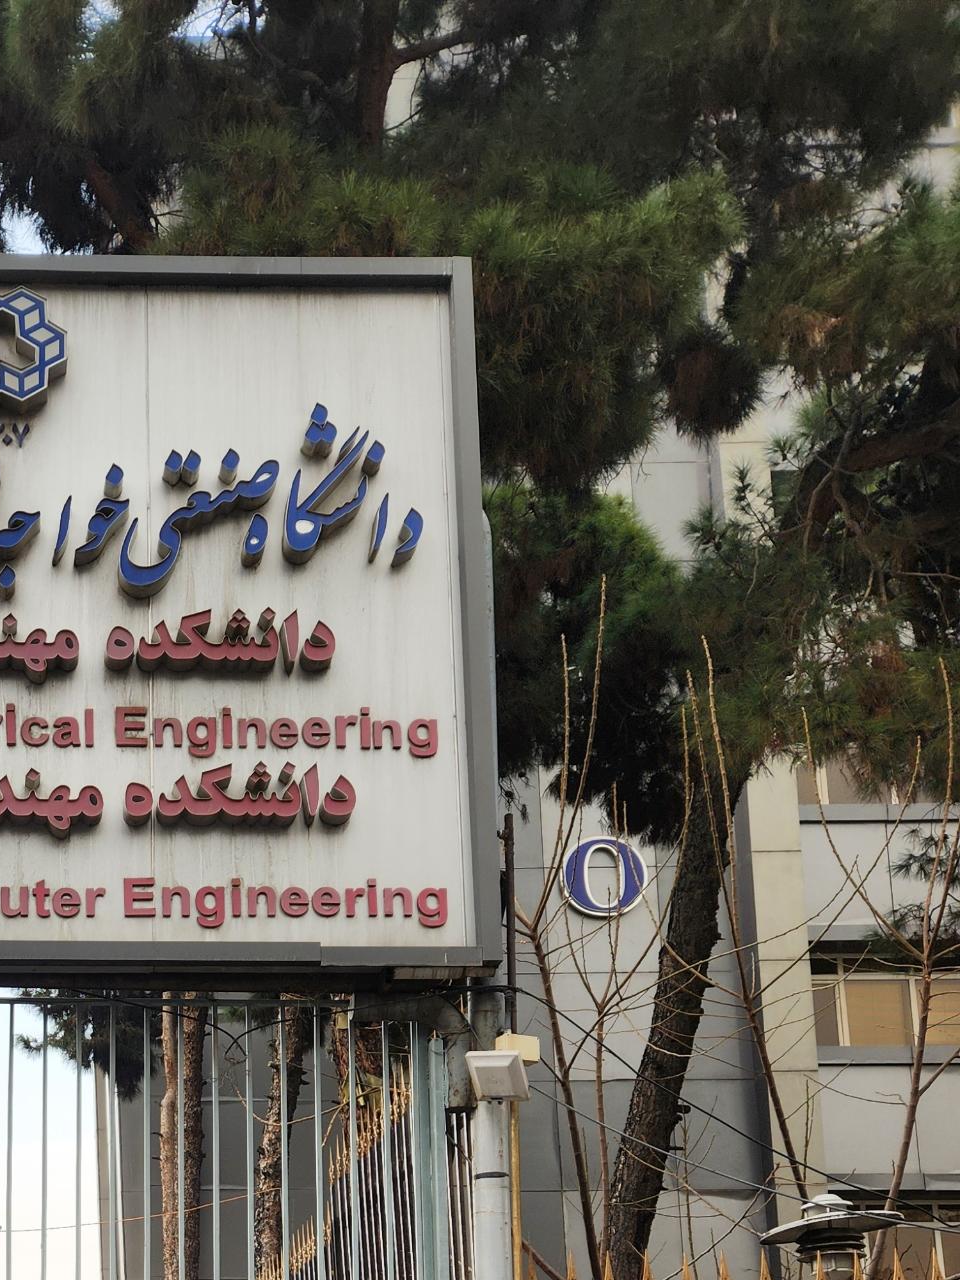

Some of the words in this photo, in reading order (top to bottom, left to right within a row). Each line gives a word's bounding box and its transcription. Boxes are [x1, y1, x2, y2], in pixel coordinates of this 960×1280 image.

[241, 402, 425, 569] دانشگاه
[118, 447, 281, 599] صنعتی
[103, 606, 337, 675] دانشکده
[114, 705, 438, 758] Engineering
[123, 760, 358, 829] دانشکده
[122, 877, 449, 928] Engineering
